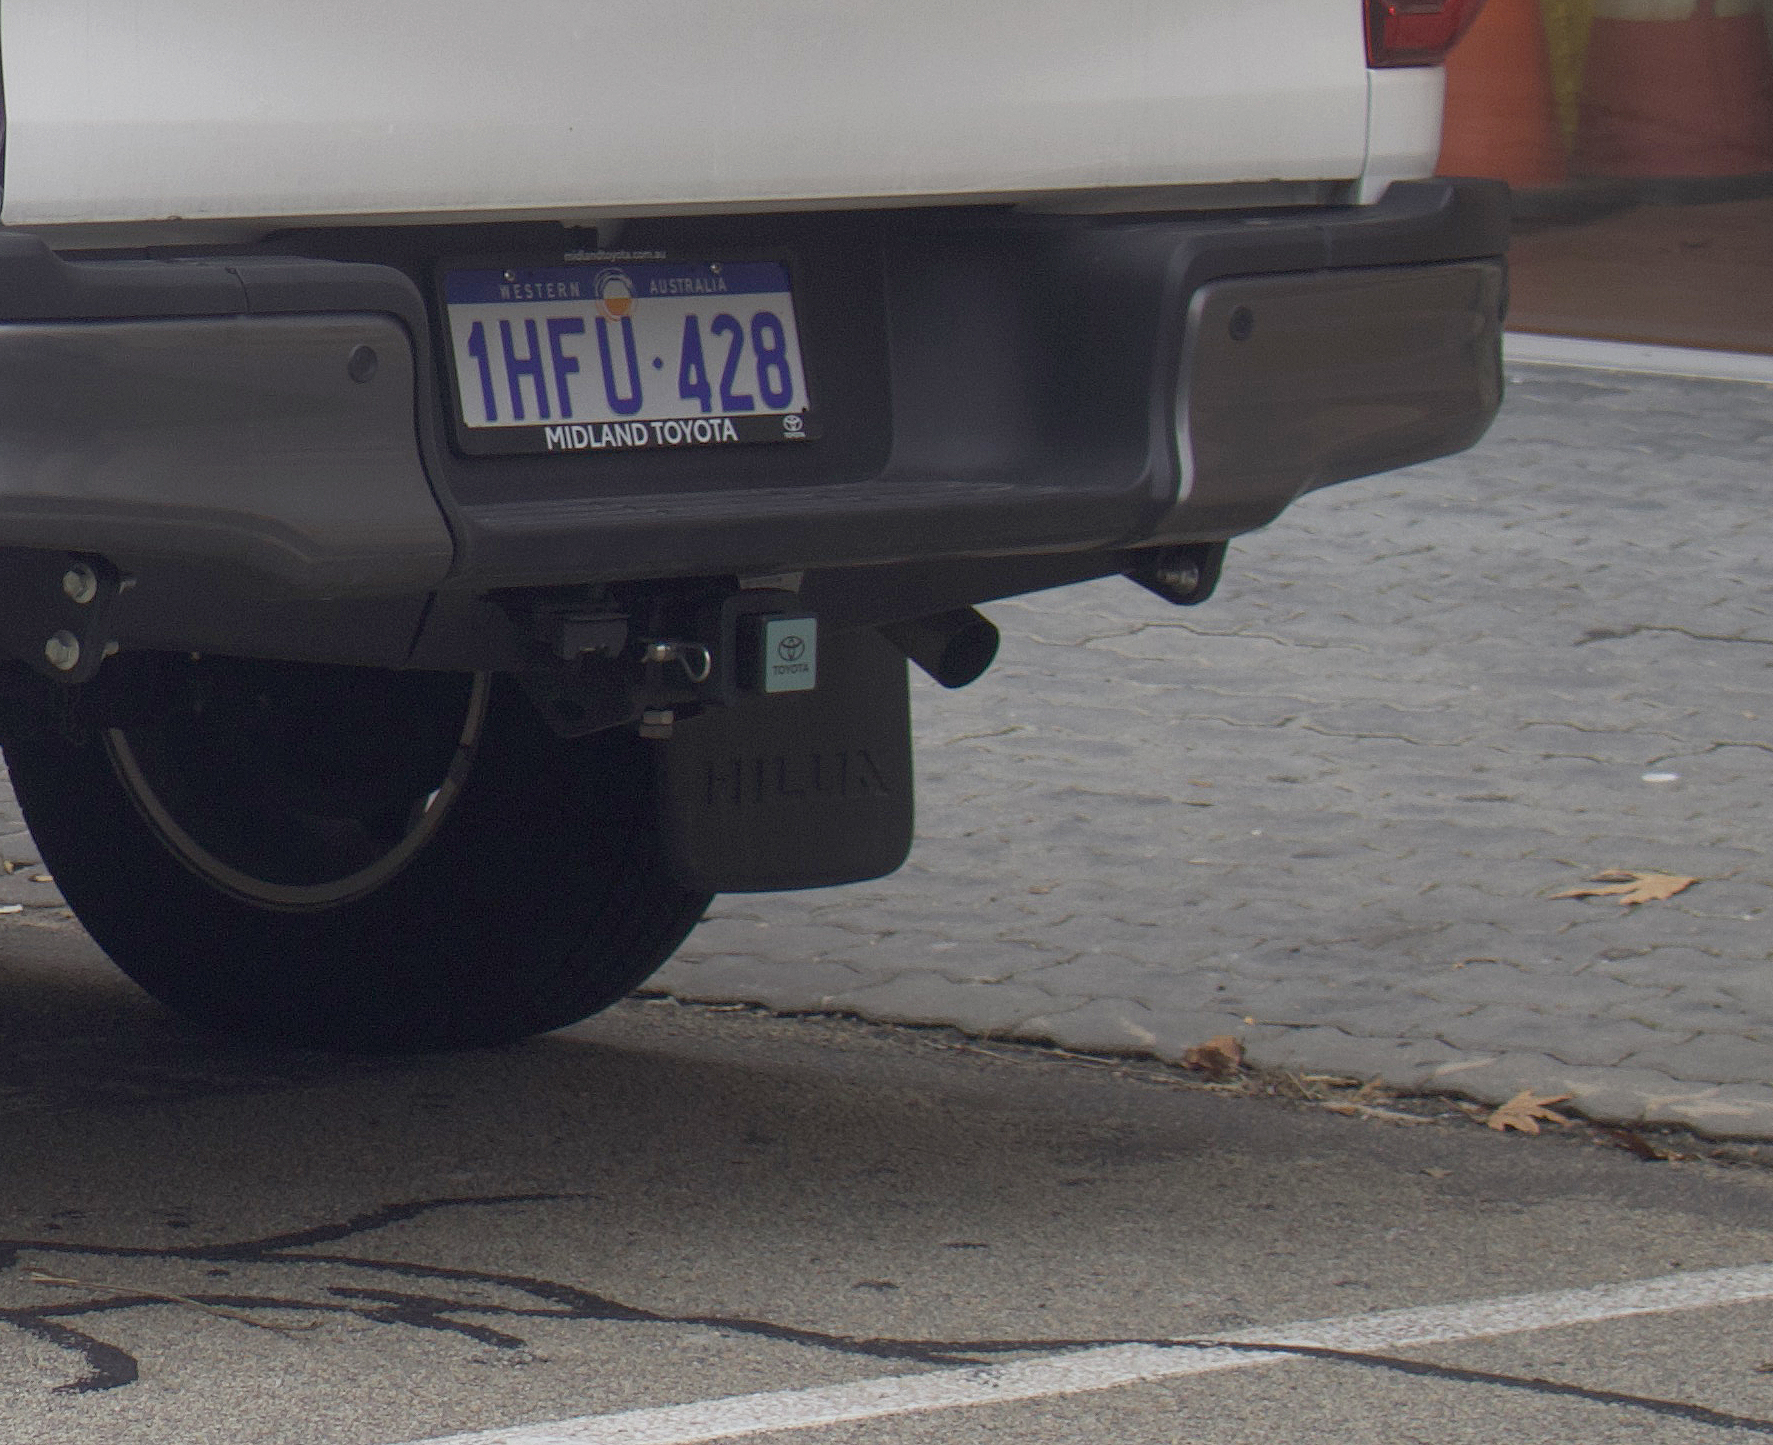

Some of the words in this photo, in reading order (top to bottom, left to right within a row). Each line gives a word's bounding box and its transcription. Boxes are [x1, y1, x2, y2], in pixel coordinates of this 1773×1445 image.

[499, 282, 581, 300] WESTERN
[649, 276, 729, 295] AUSTRALIA
[544, 423, 650, 451] MIDLAND
[652, 418, 739, 445] TOYOTA
[772, 663, 810, 676] TOYOTA
[703, 747, 892, 806] HILUX
